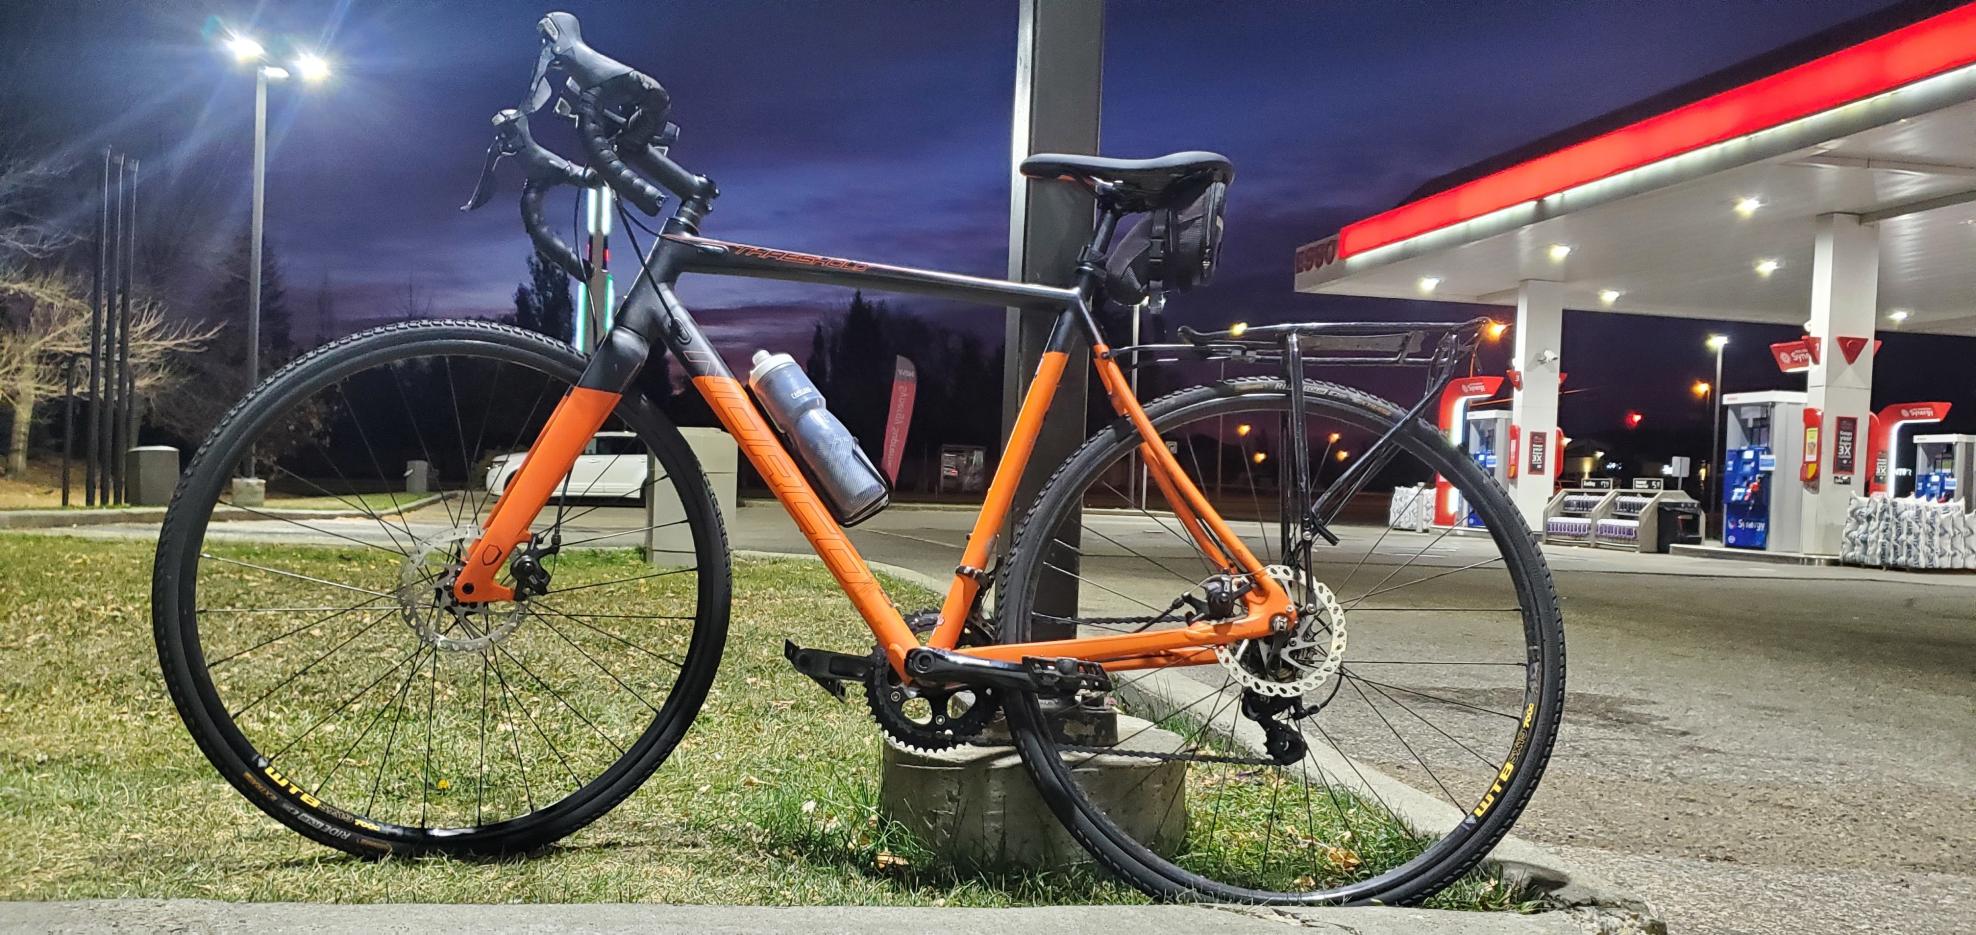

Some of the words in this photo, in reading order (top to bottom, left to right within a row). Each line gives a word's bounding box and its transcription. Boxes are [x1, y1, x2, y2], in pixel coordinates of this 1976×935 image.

[734, 245, 870, 272] THRESHOLD
[1838, 446, 1851, 456] 3X
[1738, 519, 1765, 532] Synergy
[264, 766, 321, 808] WTB
[1474, 761, 1514, 817] WTB
[321, 825, 352, 840] RIDE
